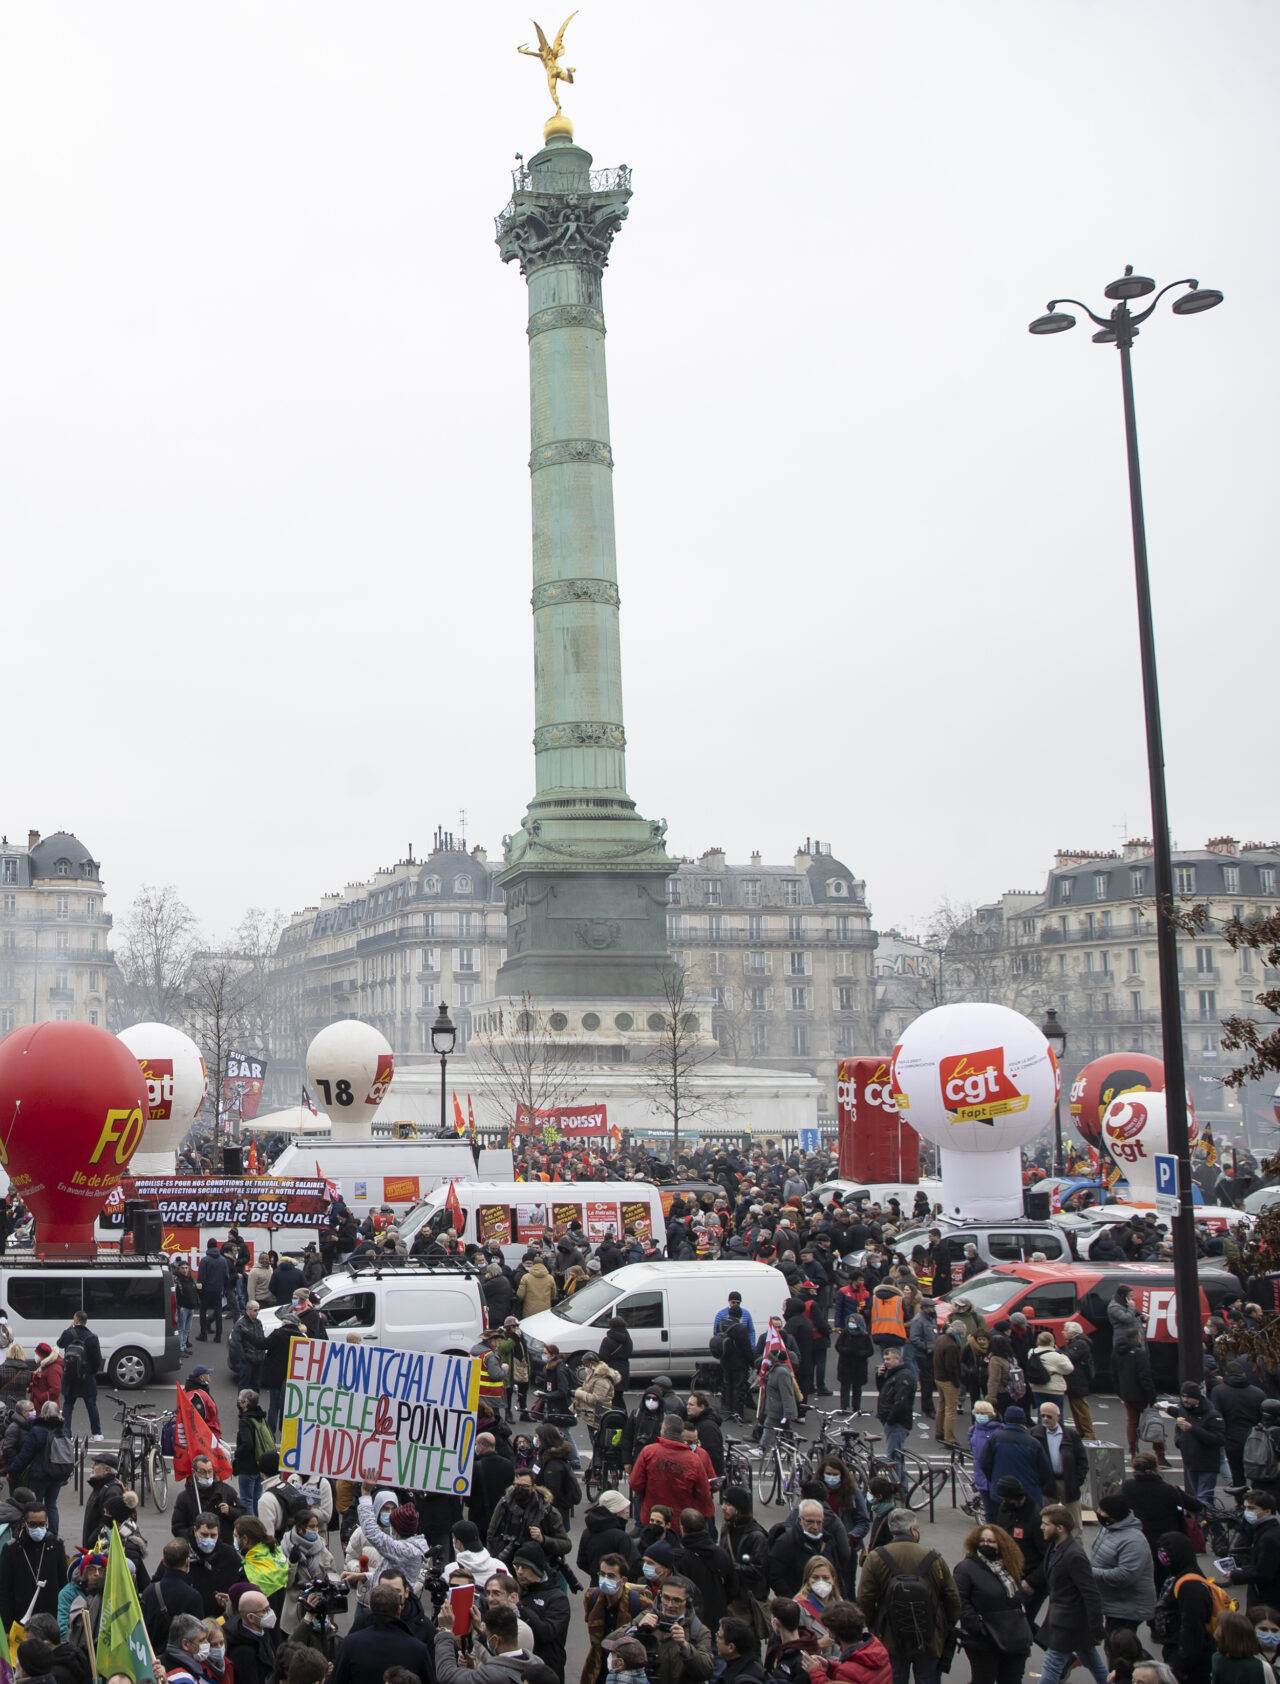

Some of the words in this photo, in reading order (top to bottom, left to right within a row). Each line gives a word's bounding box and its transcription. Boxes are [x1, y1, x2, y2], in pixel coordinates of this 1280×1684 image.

[227, 1061, 262, 1079] BAR
[948, 1057, 997, 1081] la
[146, 1074, 174, 1107] gt
[316, 1079, 354, 1106] 78
[369, 1083, 390, 1104] cg
[946, 1066, 1000, 1104] cgt
[1070, 1078, 1087, 1102] gt
[864, 1083, 900, 1113] cg
[535, 1116, 558, 1128] PSA
[560, 1114, 603, 1129] POISSY
[961, 1107, 988, 1119] fapt
[88, 1107, 144, 1165] FO
[1111, 1139, 1147, 1163] cgt
[71, 1171, 86, 1185] Ile
[88, 1174, 100, 1186] de
[1160, 1163, 1170, 1187] P
[105, 1186, 125, 1205] gt
[158, 1201, 232, 1212] GARANTIR
[249, 1201, 287, 1212] TOUS
[196, 1212, 247, 1223] PUBLIC
[251, 1212, 269, 1223] DE
[161, 1233, 200, 1251] la
[290, 1340, 327, 1382] EH
[285, 1382, 379, 1432] DÉGÈLE
[369, 1393, 397, 1441] le
[452, 1415, 476, 1495] !
